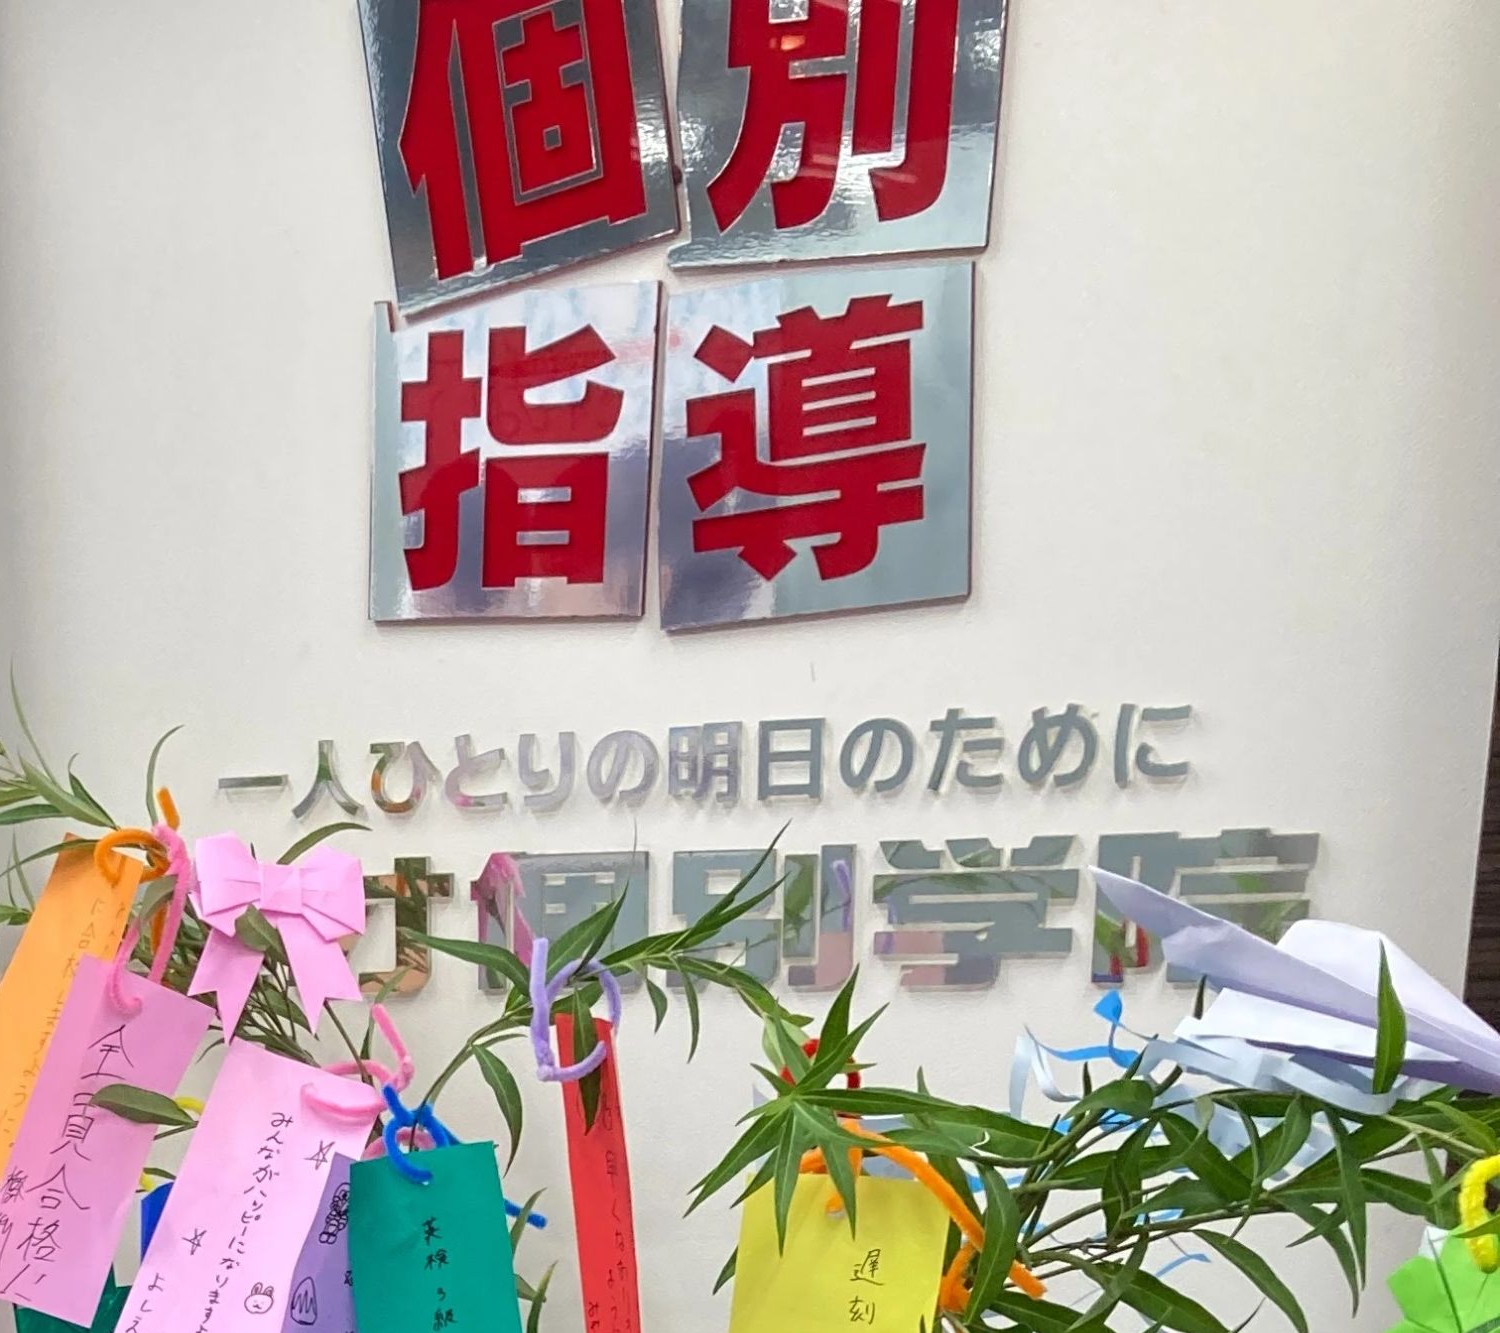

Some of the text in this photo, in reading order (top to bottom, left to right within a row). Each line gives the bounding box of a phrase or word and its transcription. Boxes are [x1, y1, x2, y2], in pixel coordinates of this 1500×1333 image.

[399, 0, 958, 281] 個別
[397, 294, 927, 592] 指導
[217, 702, 1193, 815] 一人ひとりの明日のために
